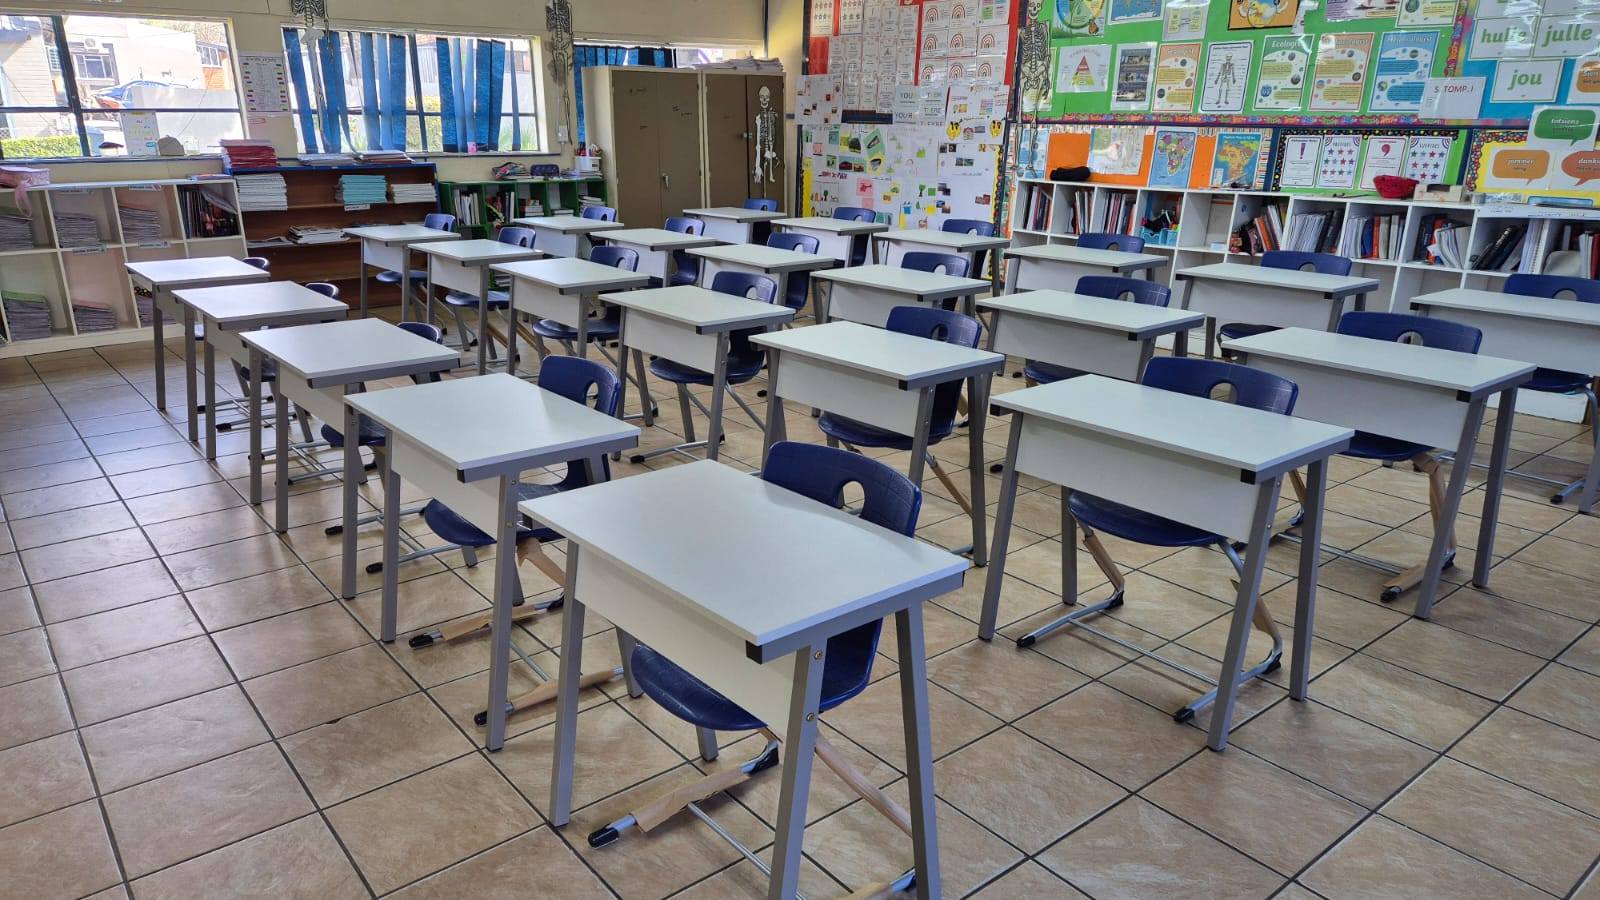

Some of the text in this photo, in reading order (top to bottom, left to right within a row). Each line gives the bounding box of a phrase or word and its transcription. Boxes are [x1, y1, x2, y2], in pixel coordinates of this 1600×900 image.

[1271, 39, 1307, 49] Ecologi
[1541, 23, 1593, 47] julle
[1507, 69, 1543, 91] jou
